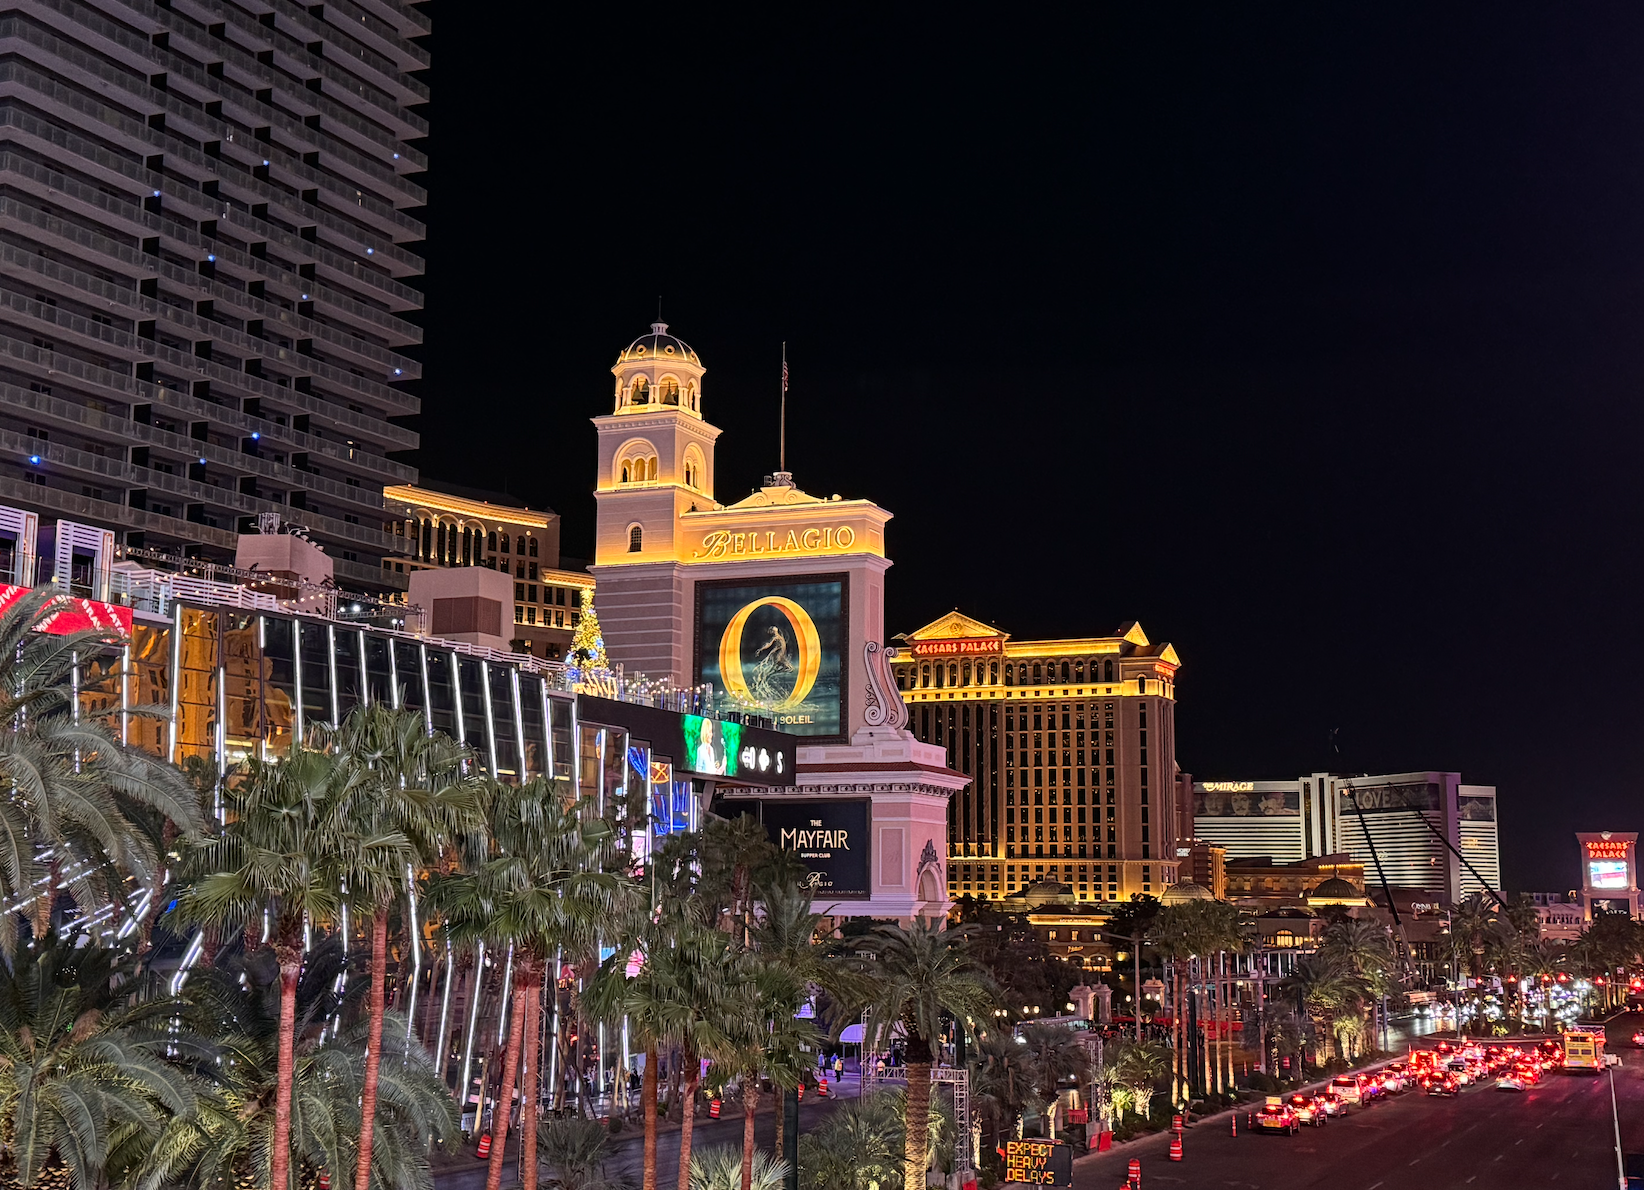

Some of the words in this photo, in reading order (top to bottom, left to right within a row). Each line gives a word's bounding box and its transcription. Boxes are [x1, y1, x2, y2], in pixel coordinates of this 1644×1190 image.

[692, 525, 856, 559] BELLAGIO
[719, 596, 821, 711] O
[915, 642, 958, 654] CAESARS
[960, 641, 999, 652] PALACE
[779, 715, 814, 725] SOLEIL
[1206, 782, 1254, 793] MIRAGE
[1356, 790, 1390, 809] LOVE
[810, 819, 822, 827] THE
[781, 827, 850, 851] MAYFAIR
[1587, 842, 1628, 850] CAESARS
[1589, 850, 1626, 858] PALACE
[1007, 1142, 1055, 1157] EXPECT
[1007, 1155, 1047, 1169] HEAVY
[1007, 1168, 1055, 1185] DELAYS
